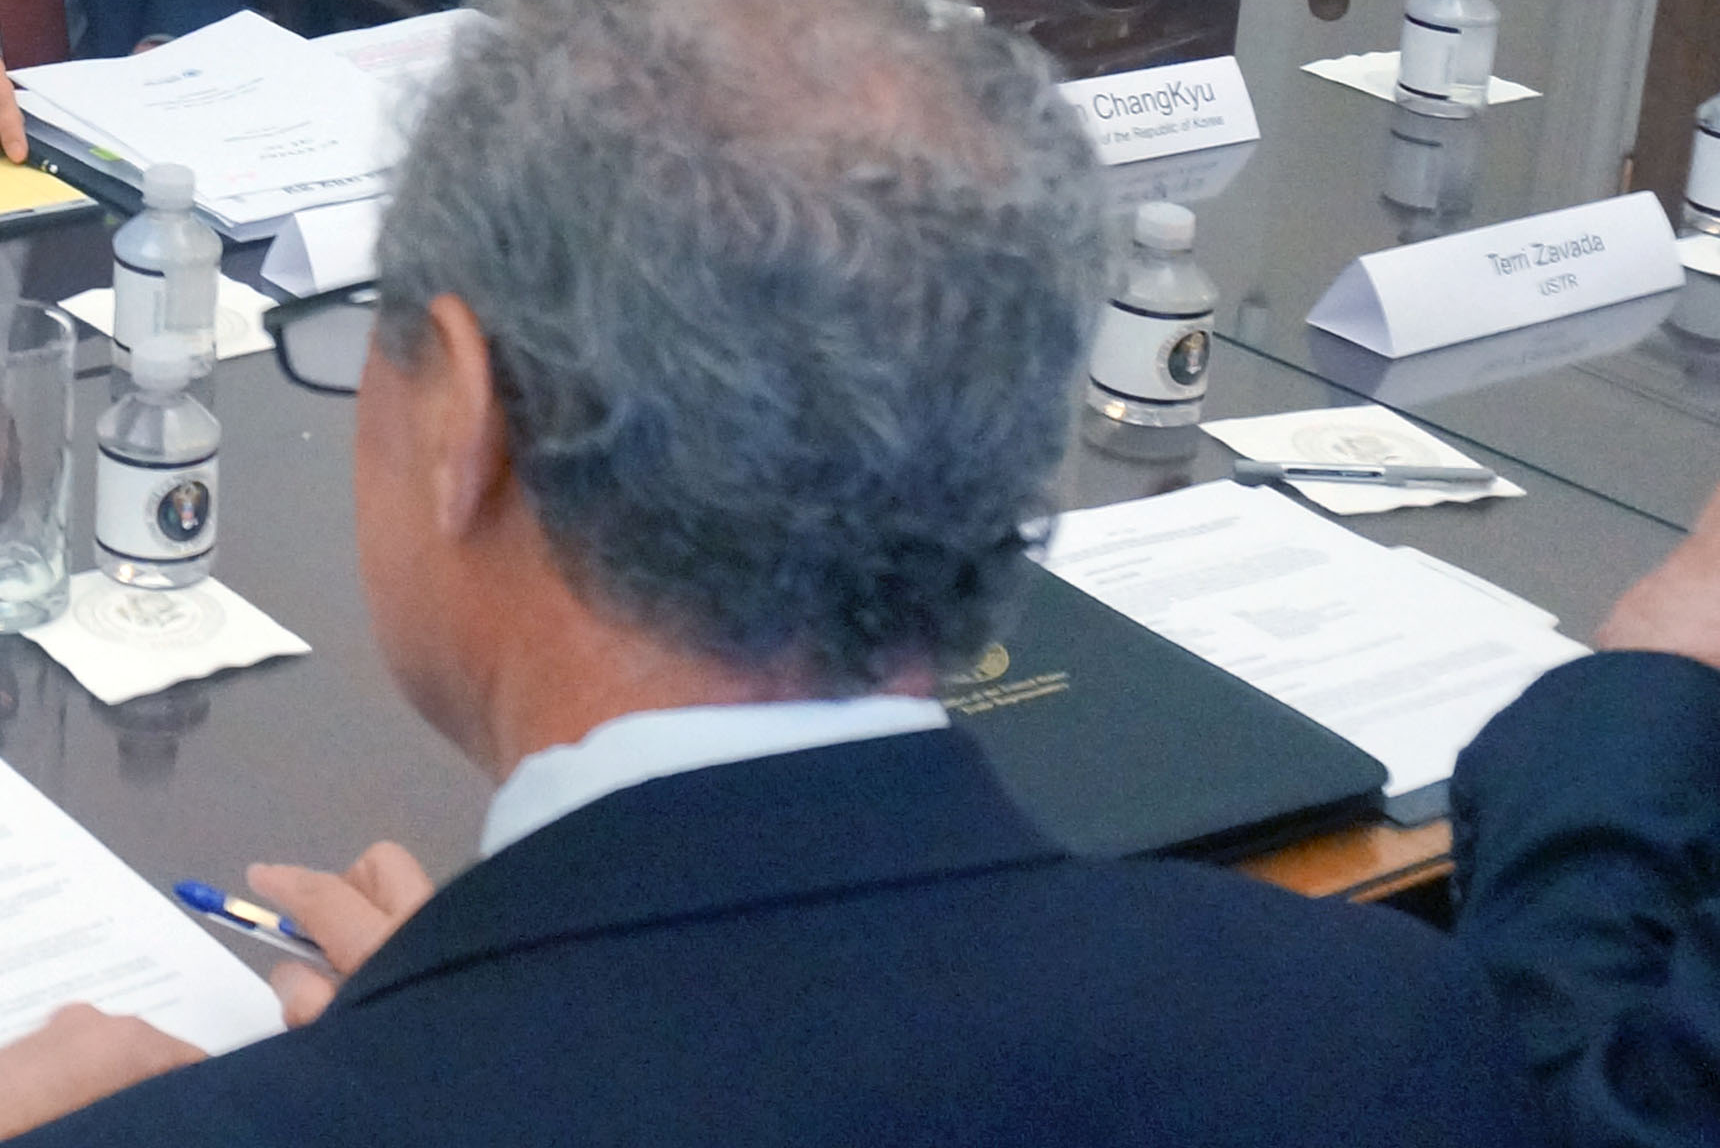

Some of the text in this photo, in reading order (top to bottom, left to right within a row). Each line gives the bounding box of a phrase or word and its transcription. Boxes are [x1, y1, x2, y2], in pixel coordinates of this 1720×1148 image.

[1093, 81, 1216, 120] ChangKyu
[1529, 233, 1606, 266] Zavada
[1538, 273, 1578, 296] USTR
